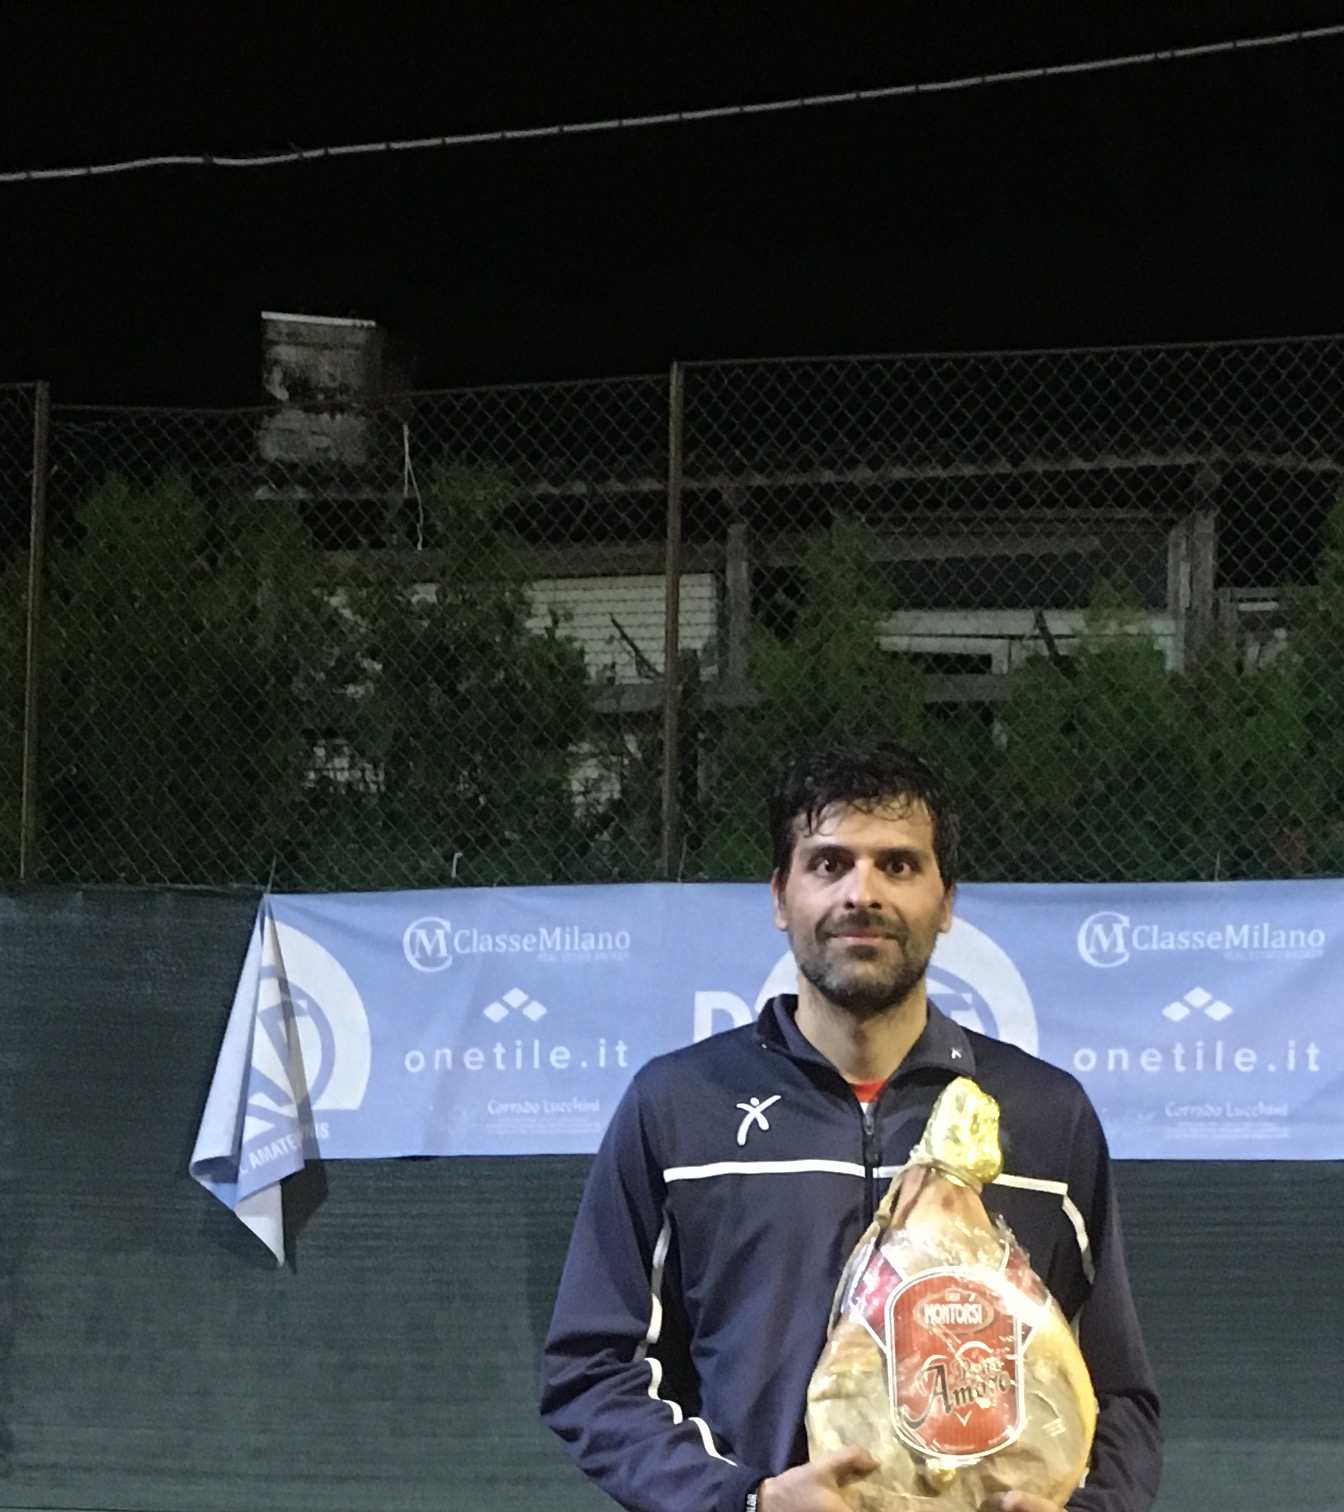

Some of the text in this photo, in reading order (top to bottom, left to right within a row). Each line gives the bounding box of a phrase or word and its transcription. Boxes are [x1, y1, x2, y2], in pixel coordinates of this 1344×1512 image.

[453, 926, 631, 954] ClasseMilano
[1132, 922, 1325, 950] ClasseMilano
[404, 1039, 629, 1073] onetile.it
[1073, 1040, 1321, 1072] onetile.it
